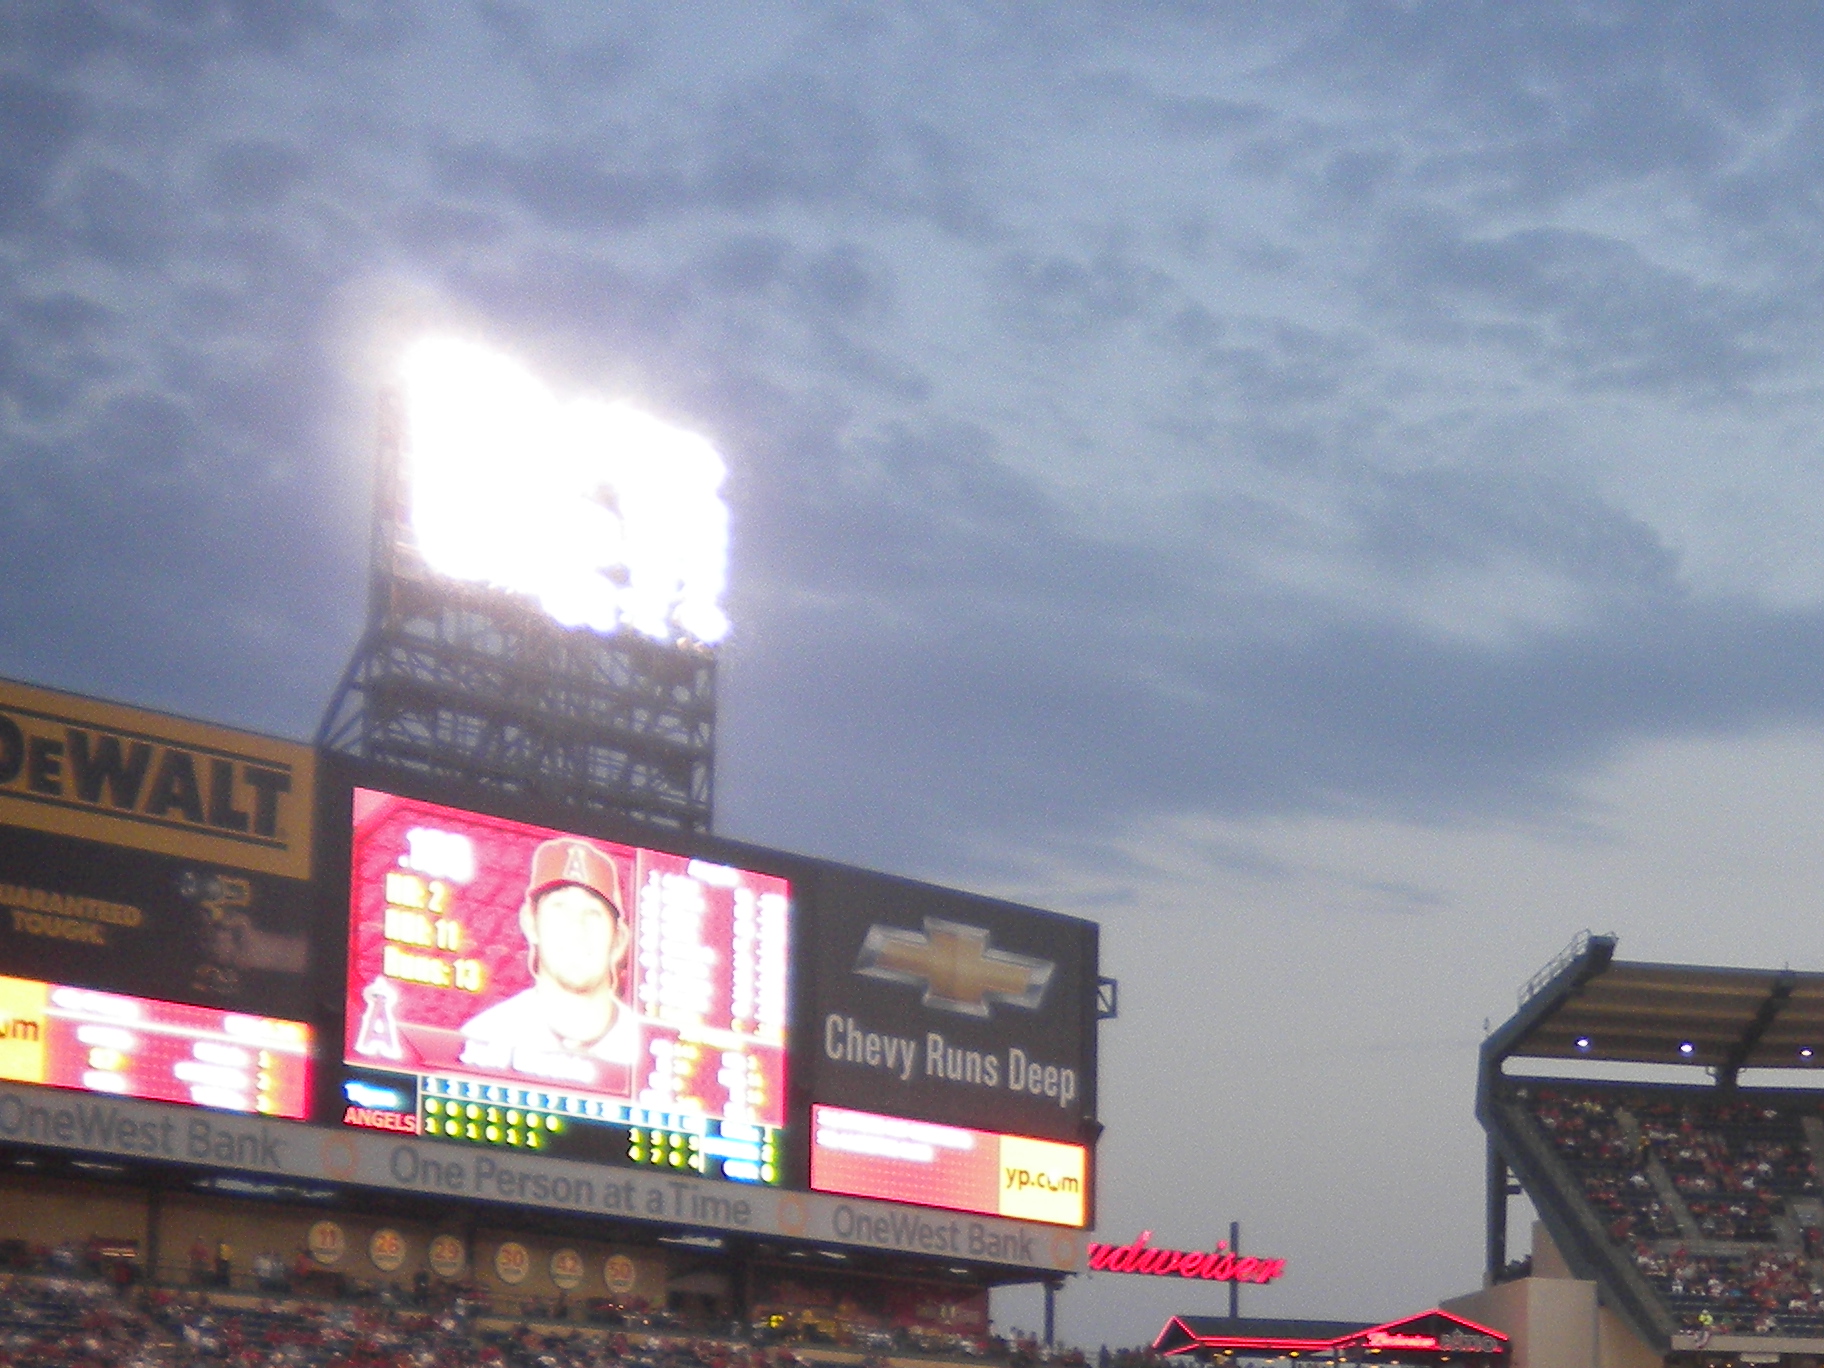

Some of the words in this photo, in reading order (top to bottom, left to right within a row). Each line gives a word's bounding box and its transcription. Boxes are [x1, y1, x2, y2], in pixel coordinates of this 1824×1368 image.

[824, 1013, 917, 1081] Chevy
[925, 1032, 1000, 1088] Runs
[1008, 1048, 1077, 1109] Deep
[2, 1093, 174, 1152] OneWest
[188, 1119, 282, 1168] Bank
[345, 1106, 415, 1132] ANGELS
[390, 1145, 465, 1190] One
[475, 1155, 594, 1207] Person
[604, 1180, 636, 1210] at
[649, 1189, 663, 1213] a
[667, 1182, 749, 1225] Time
[1004, 1166, 1079, 1193] yp.com
[831, 1204, 960, 1248] OneWest
[968, 1224, 1034, 1262] Bank
[1087, 1229, 1287, 1284] udweiser
